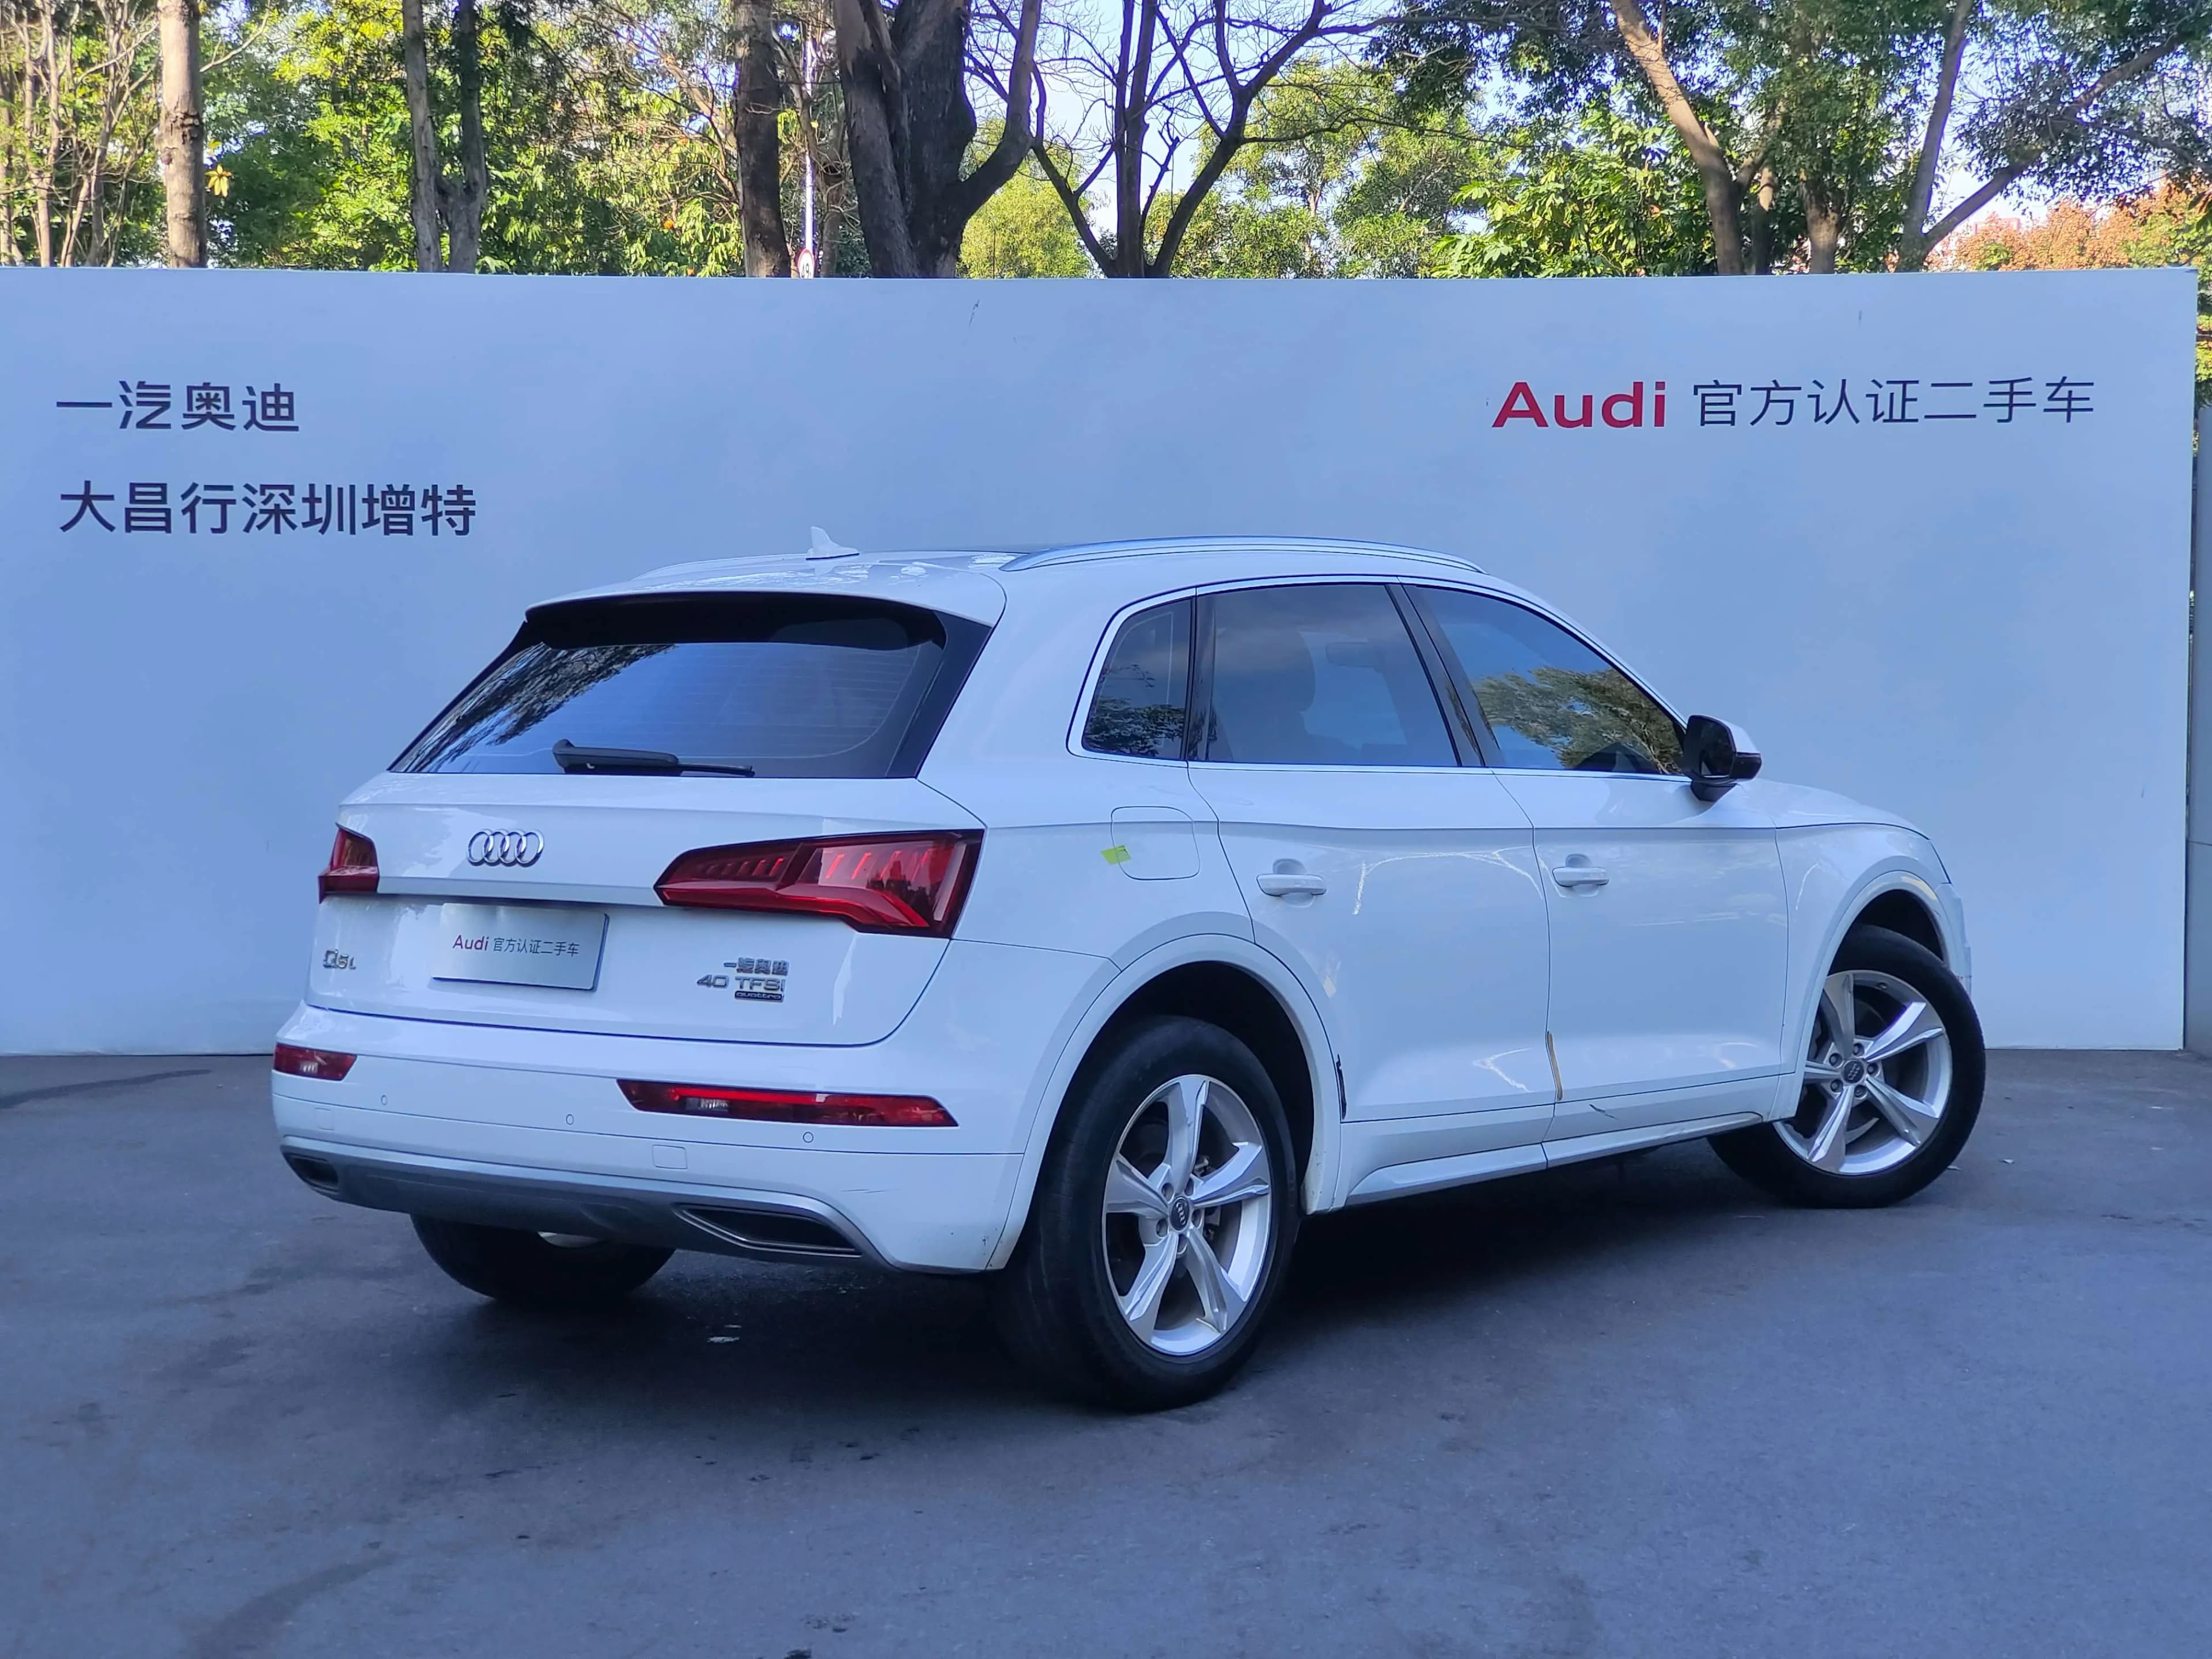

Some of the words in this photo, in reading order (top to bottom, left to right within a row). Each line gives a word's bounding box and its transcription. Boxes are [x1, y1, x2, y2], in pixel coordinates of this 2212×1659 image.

[56, 380, 300, 432] 一汽奥迪
[1491, 381, 1666, 429] Audi
[1692, 376, 2094, 427] 官方认证二手车
[59, 480, 476, 536] 大昌行深圳增特
[453, 934, 489, 951] Audi
[493, 937, 579, 957] 官方认证二手车
[696, 974, 729, 988] 40
[734, 976, 786, 992] TFSI
[736, 991, 781, 999] quattro
